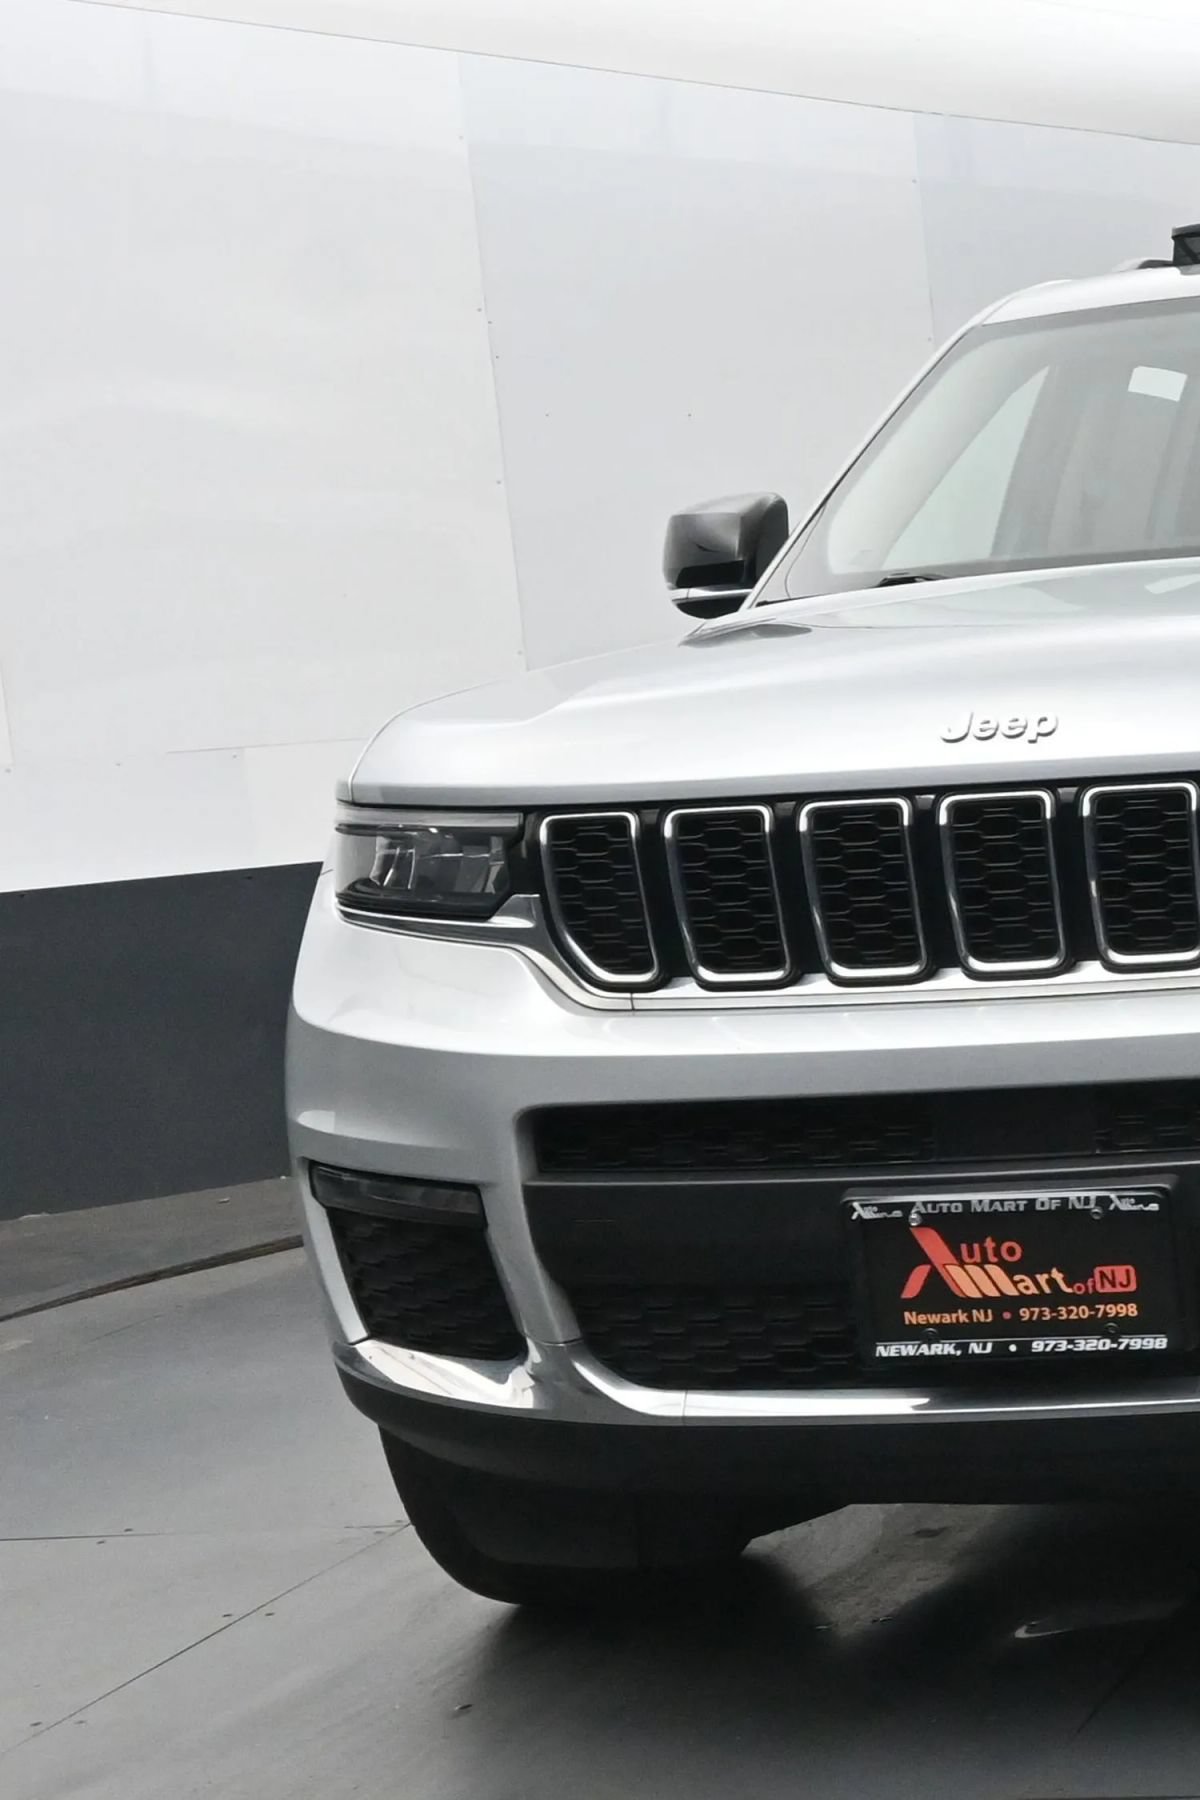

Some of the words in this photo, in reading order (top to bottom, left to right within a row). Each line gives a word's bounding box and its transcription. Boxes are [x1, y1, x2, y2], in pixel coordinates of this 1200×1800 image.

[939, 709, 1058, 744] Jeep
[911, 1200, 963, 1214] AUTO
[970, 1199, 1028, 1214] MART
[901, 1226, 1023, 1299] Auto
[943, 1264, 1073, 1299] Mart
[1073, 1278, 1096, 1295] of
[1099, 1268, 1132, 1289] NJ
[903, 1309, 969, 1325] Newark
[971, 1308, 994, 1323] NJ
[1018, 1303, 1139, 1321] 973-320-7998
[875, 1343, 962, 1358] NEWARK,
[968, 1342, 994, 1355] NJ
[1031, 1337, 1168, 1353] 973-320-7998
